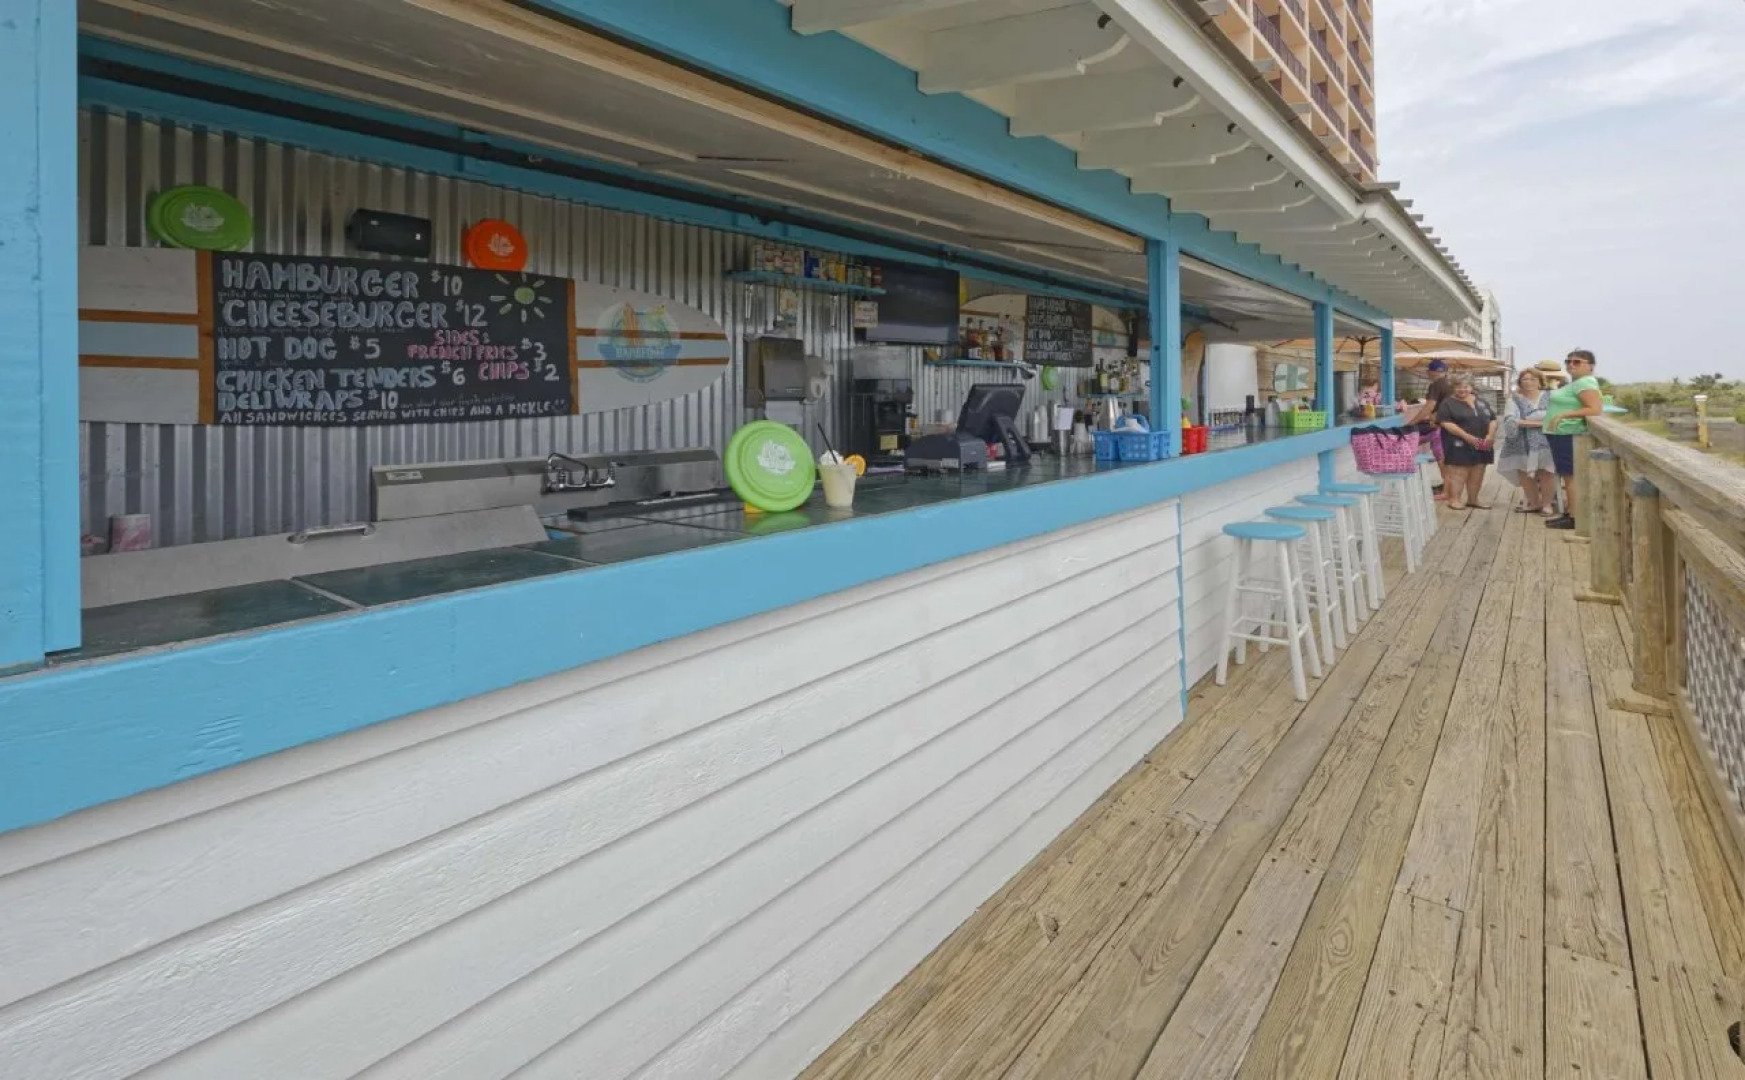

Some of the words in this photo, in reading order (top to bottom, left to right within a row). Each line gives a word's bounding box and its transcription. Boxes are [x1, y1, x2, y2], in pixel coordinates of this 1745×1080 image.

[222, 259, 419, 298] HAMBURGER
[431, 269, 463, 297] $10
[222, 299, 448, 328] CHEESEBURGER
[455, 299, 488, 327] $12
[217, 336, 272, 360] HOT
[284, 336, 338, 360] DOG
[475, 344, 519, 360] FRIES
[216, 367, 325, 392] CHICKEN
[329, 365, 437, 389] TENDERS
[478, 361, 530, 380] CHIPS
[367, 388, 399, 410] $10
[352, 409, 397, 421] SERVED
[401, 407, 430, 418] WITH
[433, 406, 465, 417] CHIPS
[470, 404, 492, 415] AND
[495, 404, 504, 415] A
[509, 401, 550, 415] PICKLE
